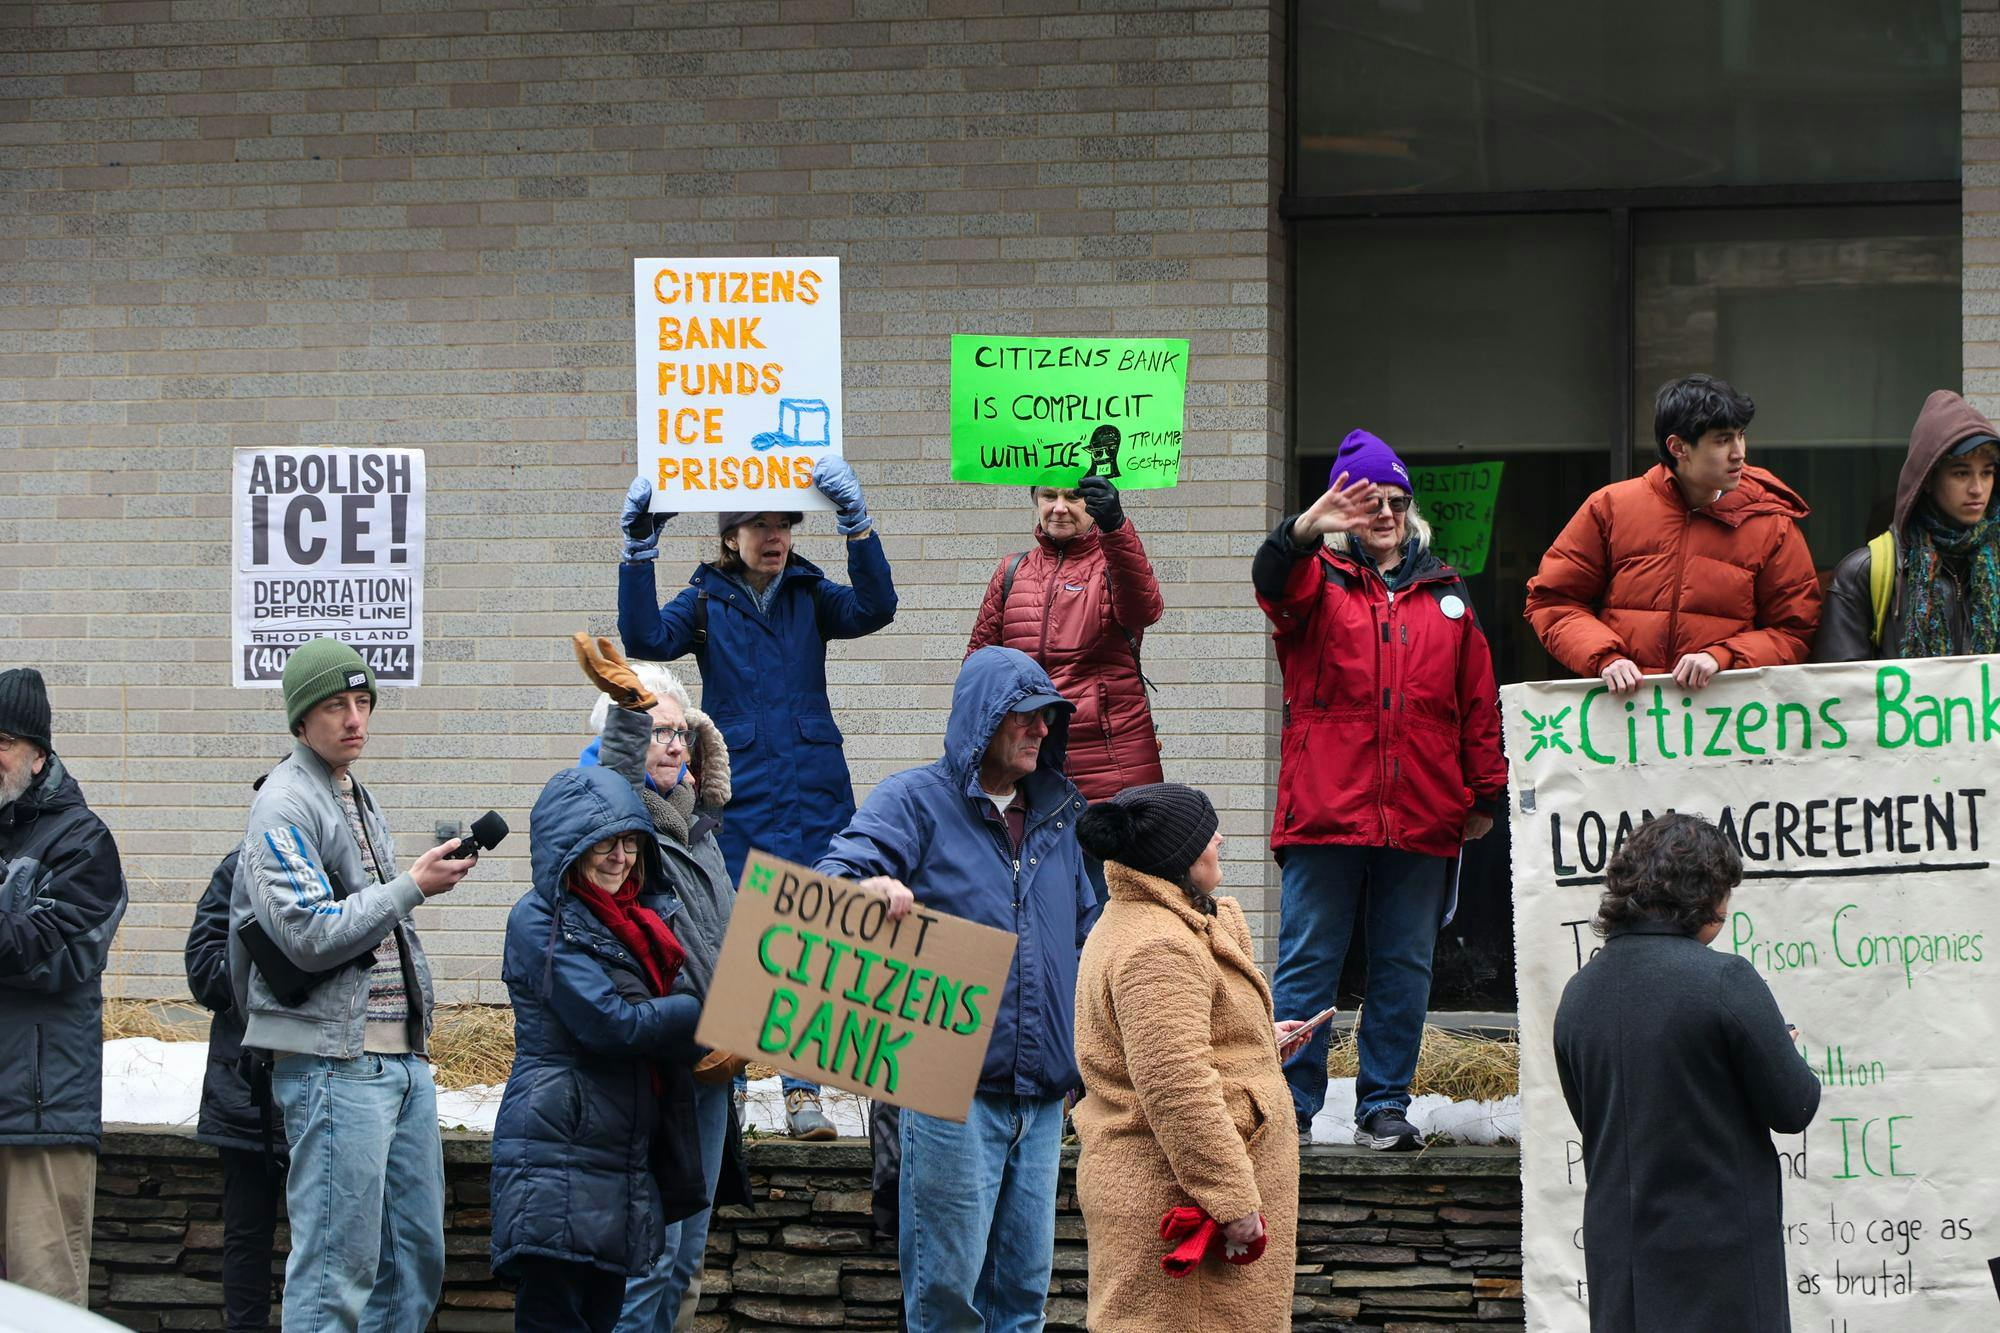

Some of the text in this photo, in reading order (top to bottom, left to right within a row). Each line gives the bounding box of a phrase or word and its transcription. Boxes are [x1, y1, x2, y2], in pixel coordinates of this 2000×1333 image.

[658, 316, 768, 351] BANK
[658, 361, 784, 396] FUNDS
[975, 346, 1180, 373] CITIZENS BANK
[658, 407, 724, 445] ICE
[1012, 394, 1153, 423] COMPLICIT
[248, 454, 411, 494] ABOLISH
[657, 455, 815, 491] PRISONS
[980, 445, 1038, 469] WITH
[252, 494, 408, 565] ICE!
[254, 578, 406, 605] DEPORTATION
[254, 604, 406, 620] DEFENSE LINE
[335, 630, 409, 641] ISLAND
[249, 646, 295, 678] (40
[1579, 685, 1847, 764] Citizens
[1551, 788, 1986, 875] LOA AGREEMENT
[1833, 904, 1984, 989] Companies
[758, 924, 989, 1036] CITIZENS
[758, 987, 914, 1094] BANK
[1778, 1115, 1917, 1180] nd ICE
[1829, 1203, 1855, 1243] to
[1866, 1219, 1922, 1255] cage
[1941, 1217, 1973, 1240] as
[1797, 1259, 1912, 1298] as brutal
